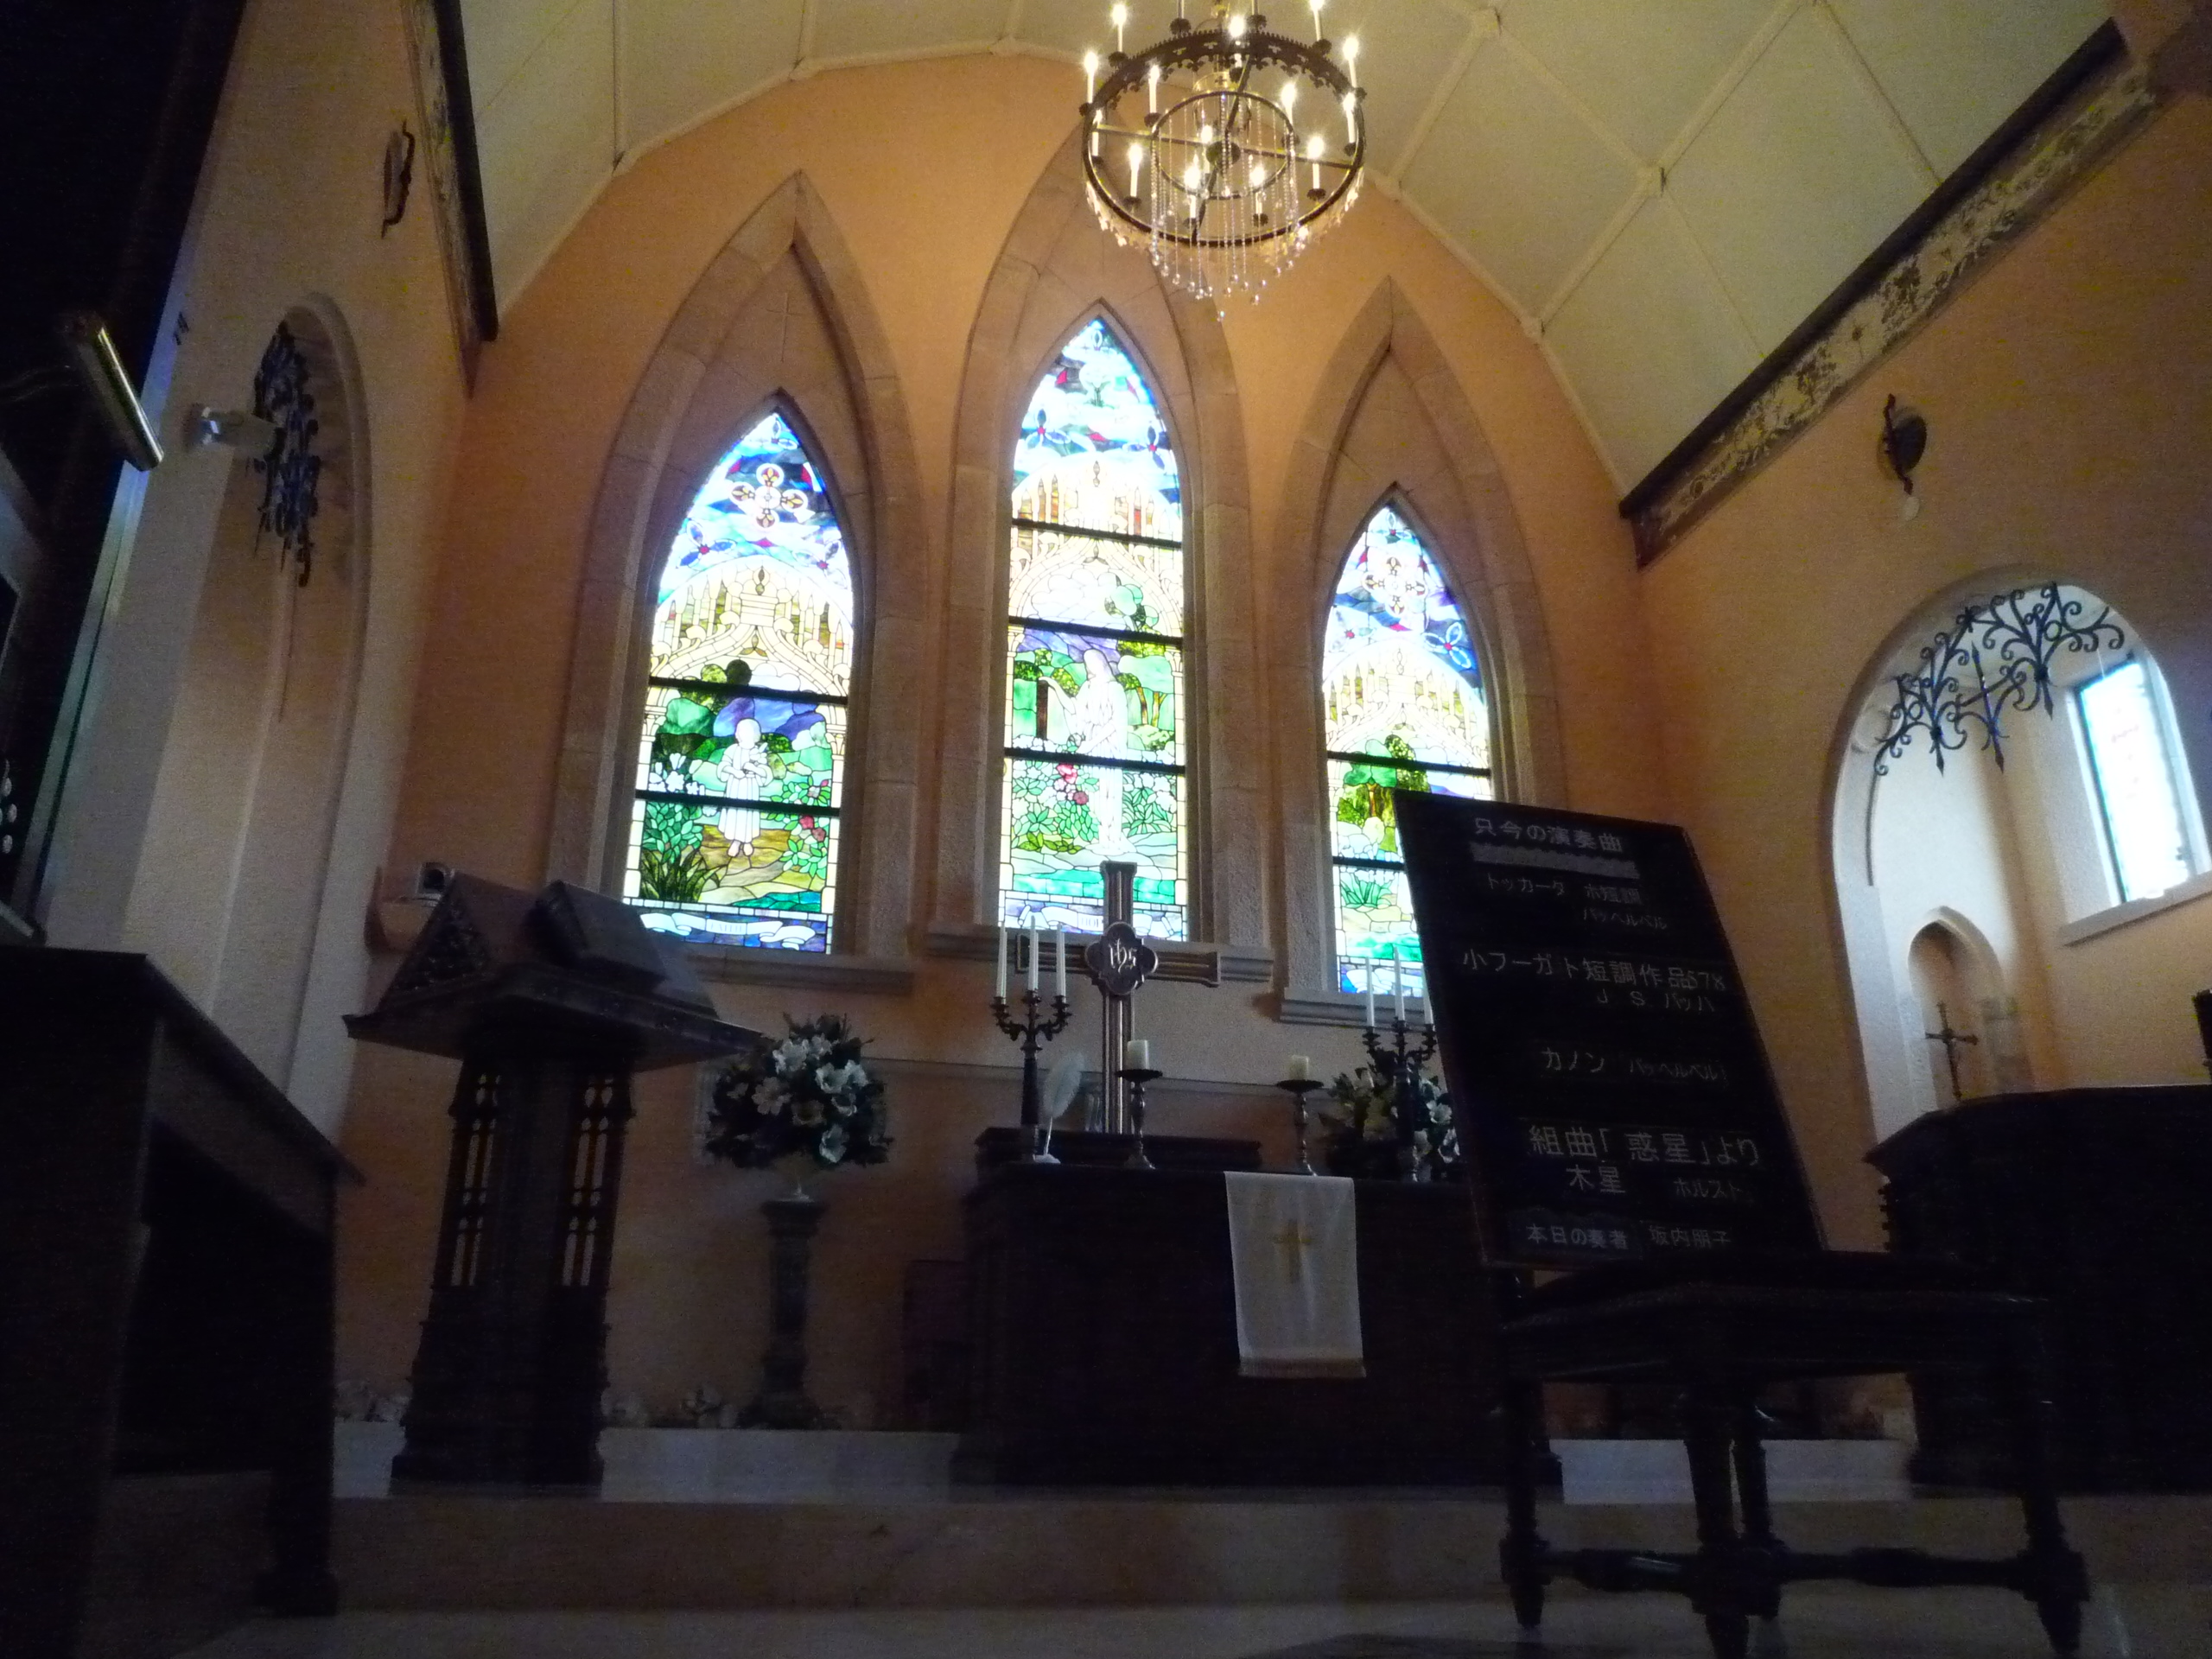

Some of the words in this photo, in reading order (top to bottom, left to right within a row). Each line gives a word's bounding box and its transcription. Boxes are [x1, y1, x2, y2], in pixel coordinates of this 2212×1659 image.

[1474, 817, 1622, 852] 只今の演奏曲
[1541, 1046, 1605, 1072] カノン
[1566, 1164, 1625, 1194] 木星
